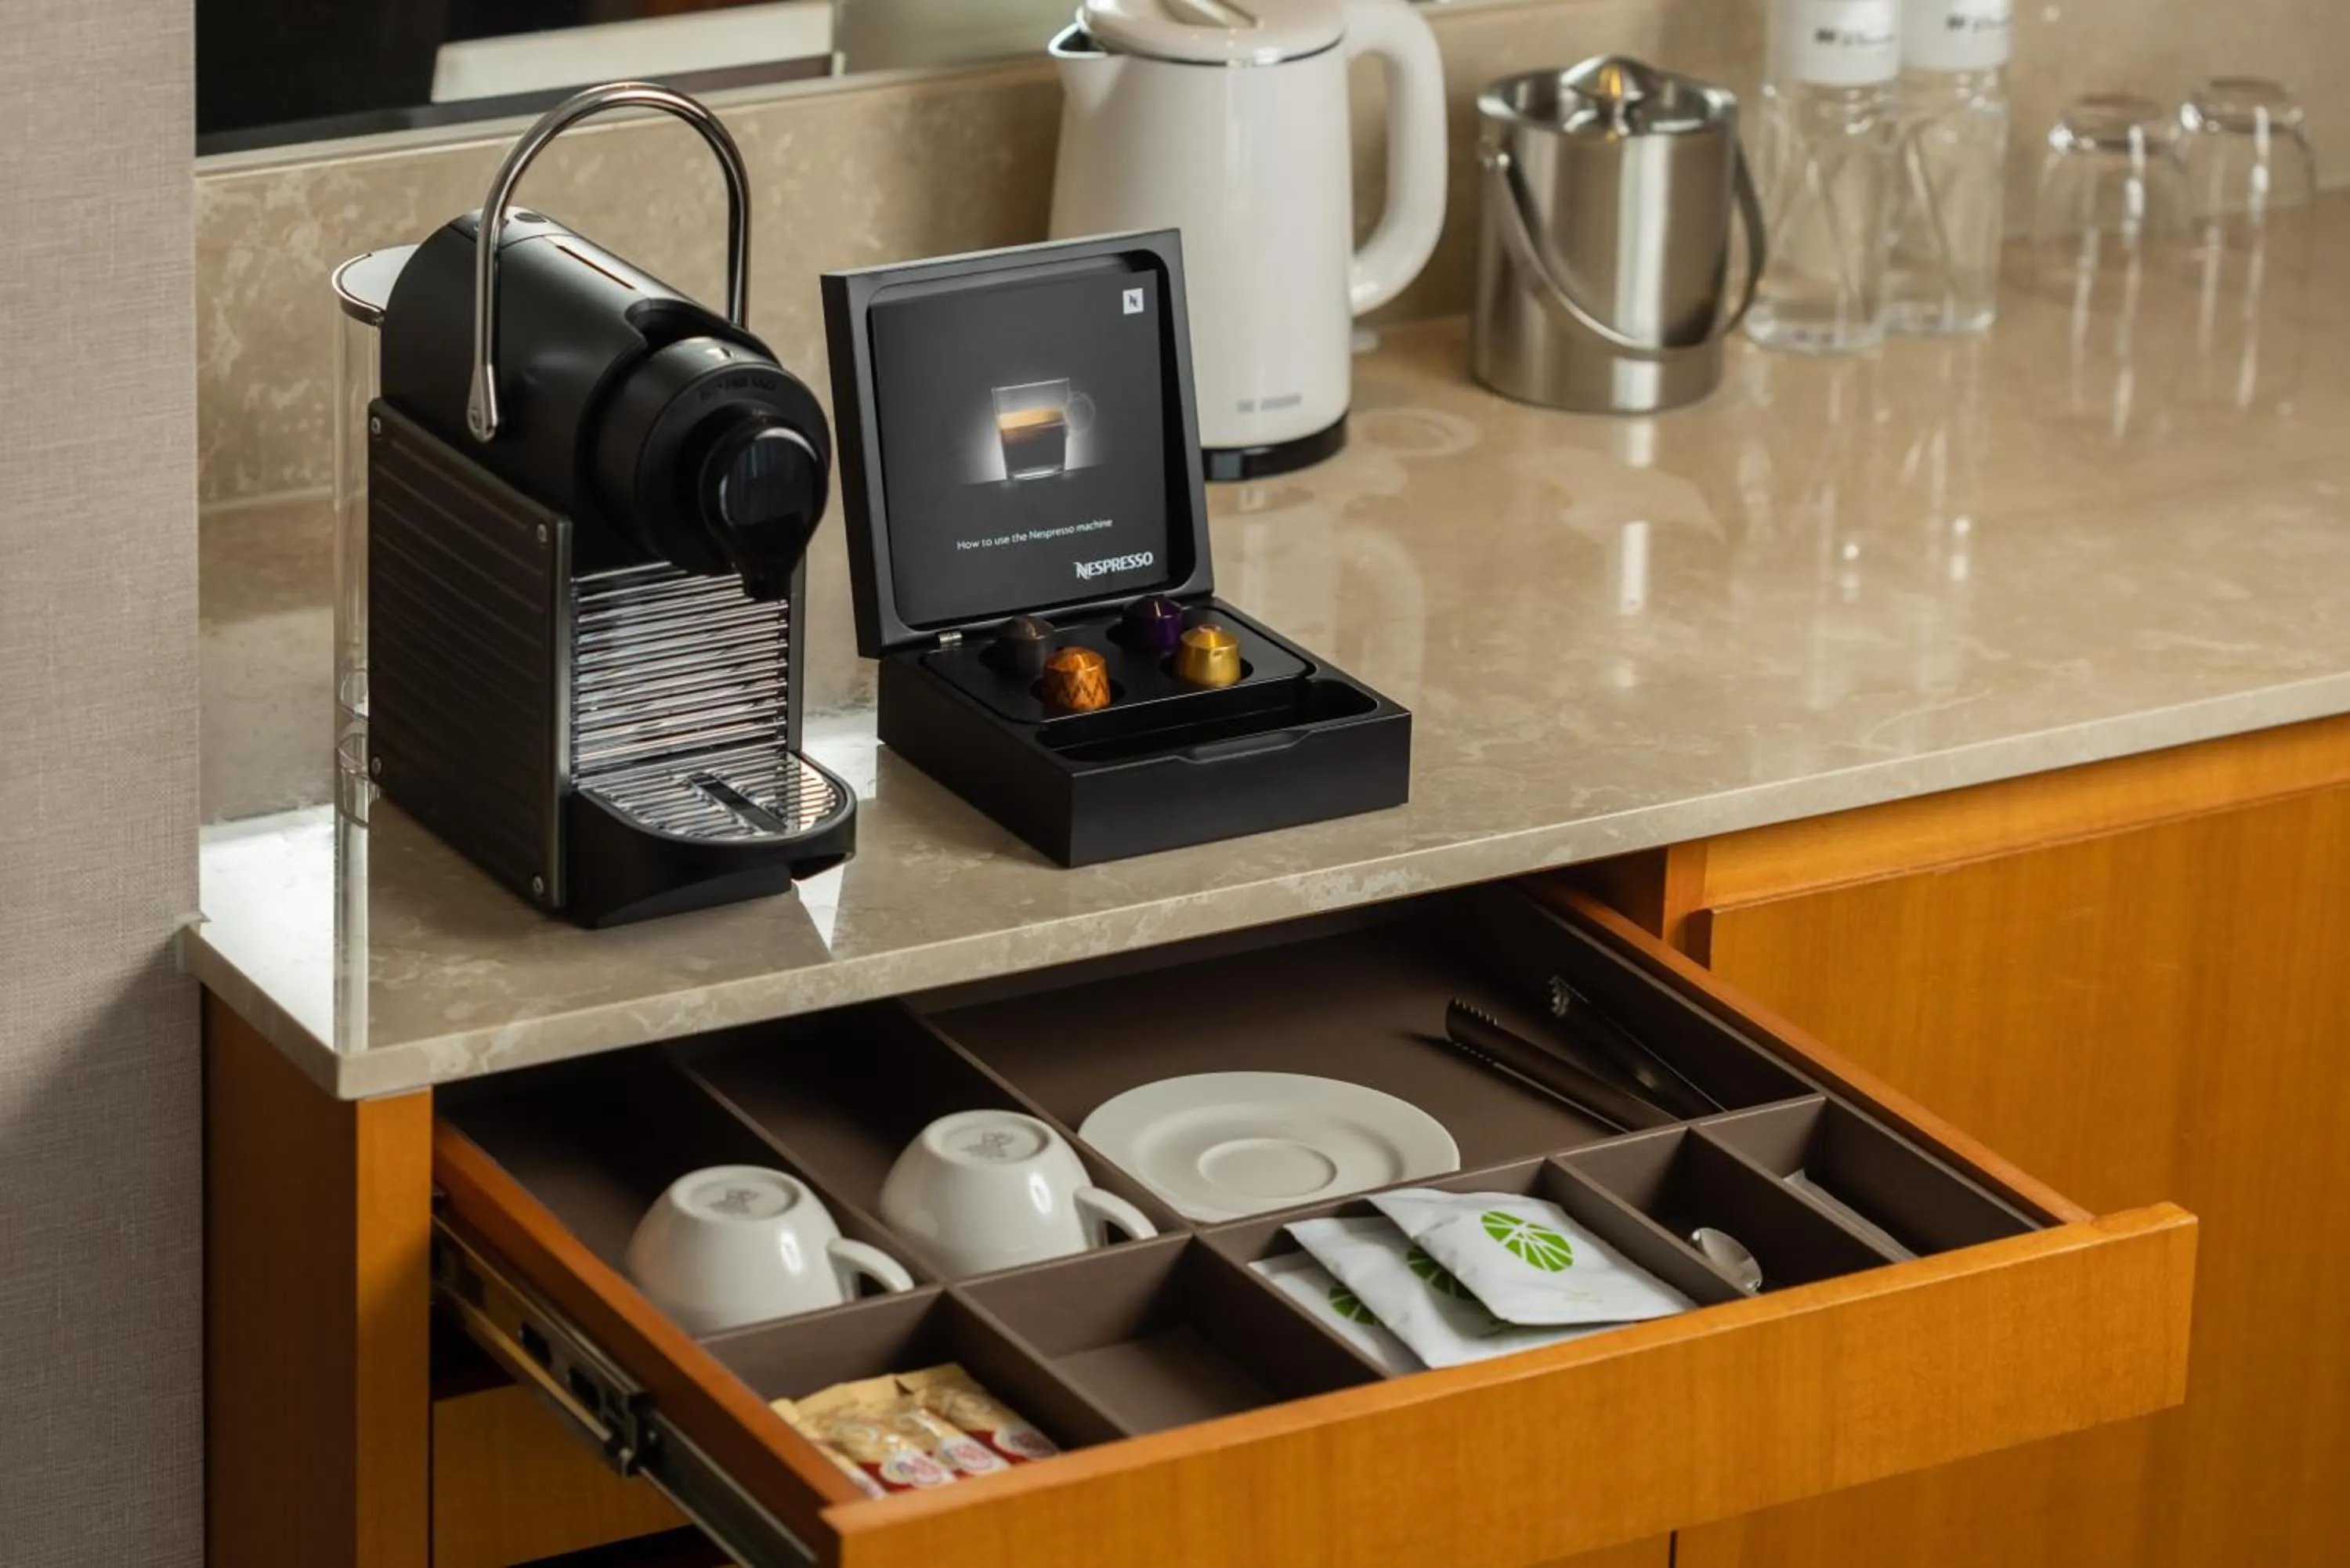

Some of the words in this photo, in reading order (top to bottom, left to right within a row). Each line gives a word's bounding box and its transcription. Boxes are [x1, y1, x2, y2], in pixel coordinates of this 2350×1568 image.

[956, 540, 980, 550] How
[982, 539, 992, 547] to
[994, 537, 1010, 546] use
[1012, 533, 1028, 543] the
[1029, 525, 1075, 540] Nespresso
[1076, 518, 1113, 533] machine
[1073, 551, 1154, 580] NESPRESSO
